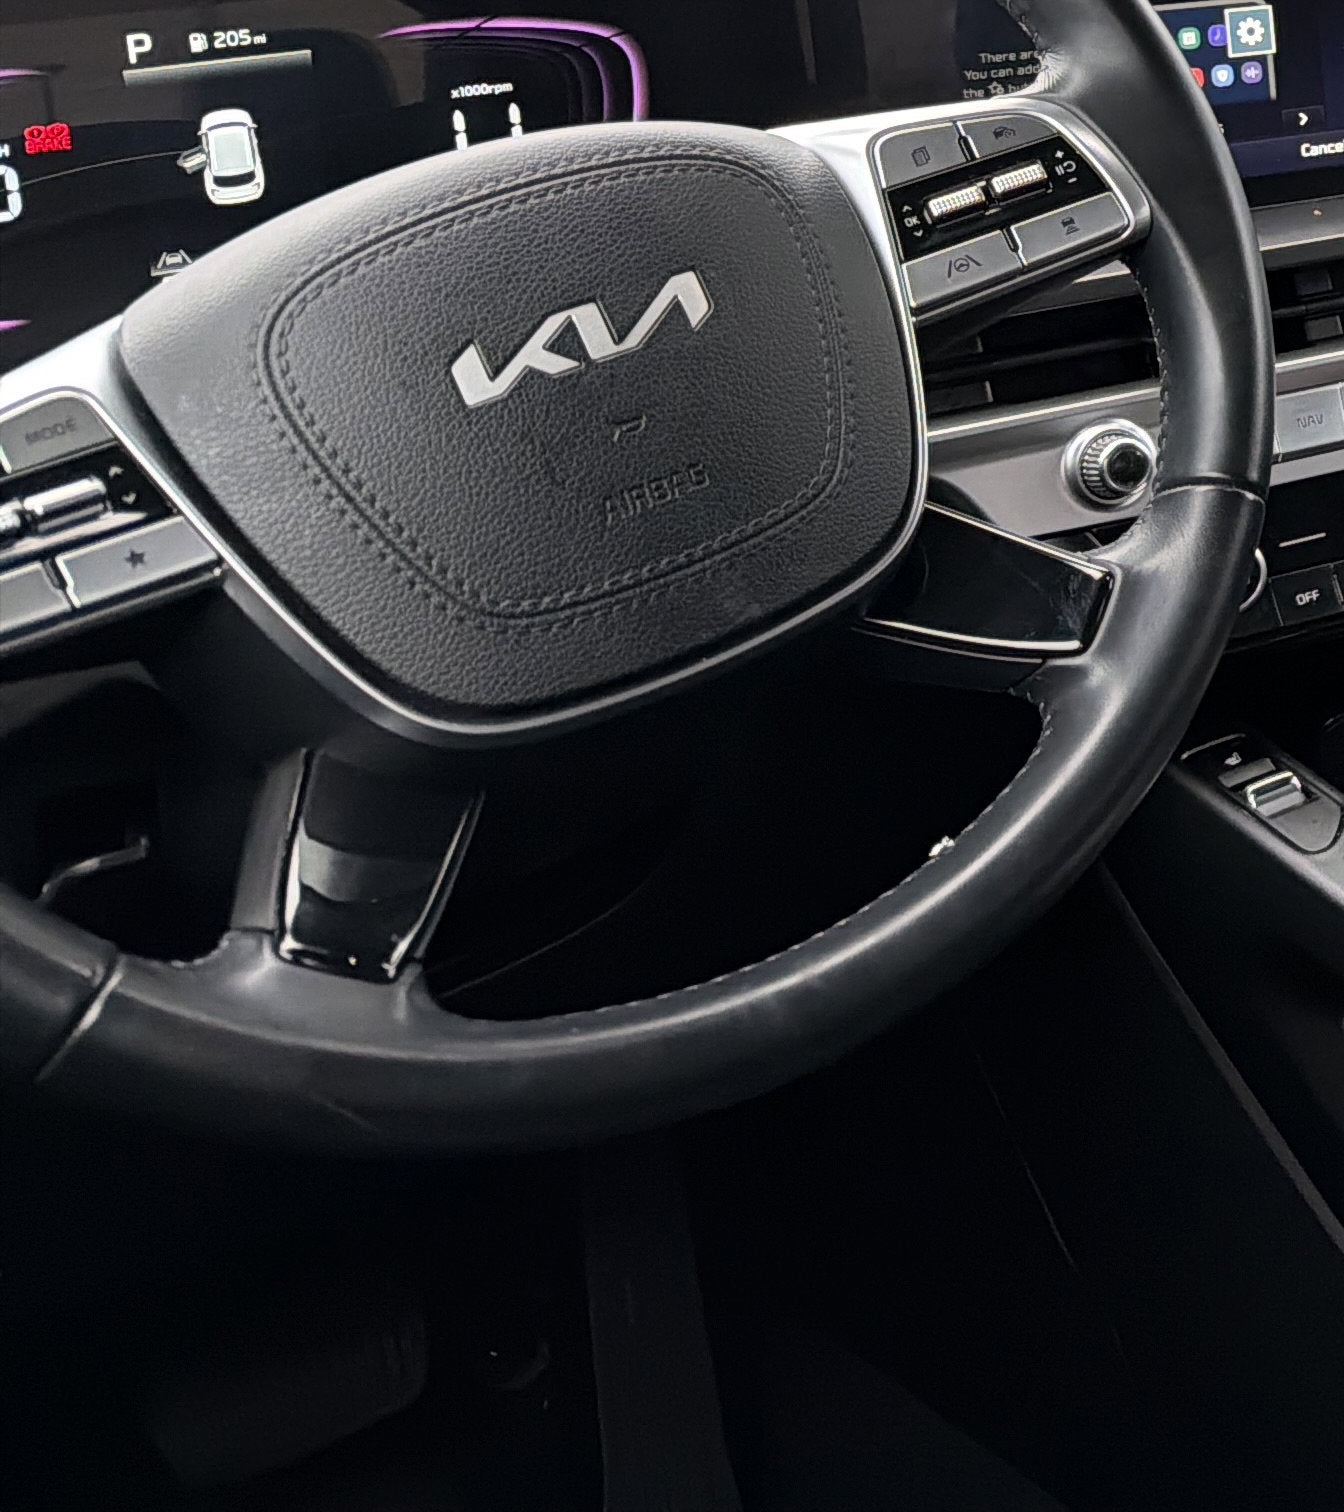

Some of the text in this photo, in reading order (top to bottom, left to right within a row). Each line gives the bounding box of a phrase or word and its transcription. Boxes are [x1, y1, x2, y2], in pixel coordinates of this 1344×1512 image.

[213, 29, 267, 48] 205 mi
[126, 32, 152, 64] P
[977, 51, 1017, 64] There
[964, 69, 988, 80] You
[991, 67, 1014, 78] can
[450, 82, 513, 100] x1000rpm
[963, 88, 985, 99] the
[903, 216, 921, 228] OK
[451, 269, 714, 409] KIA
[25, 414, 77, 444] MODE
[1296, 414, 1324, 428] NAV
[1295, 589, 1321, 606] OFF
